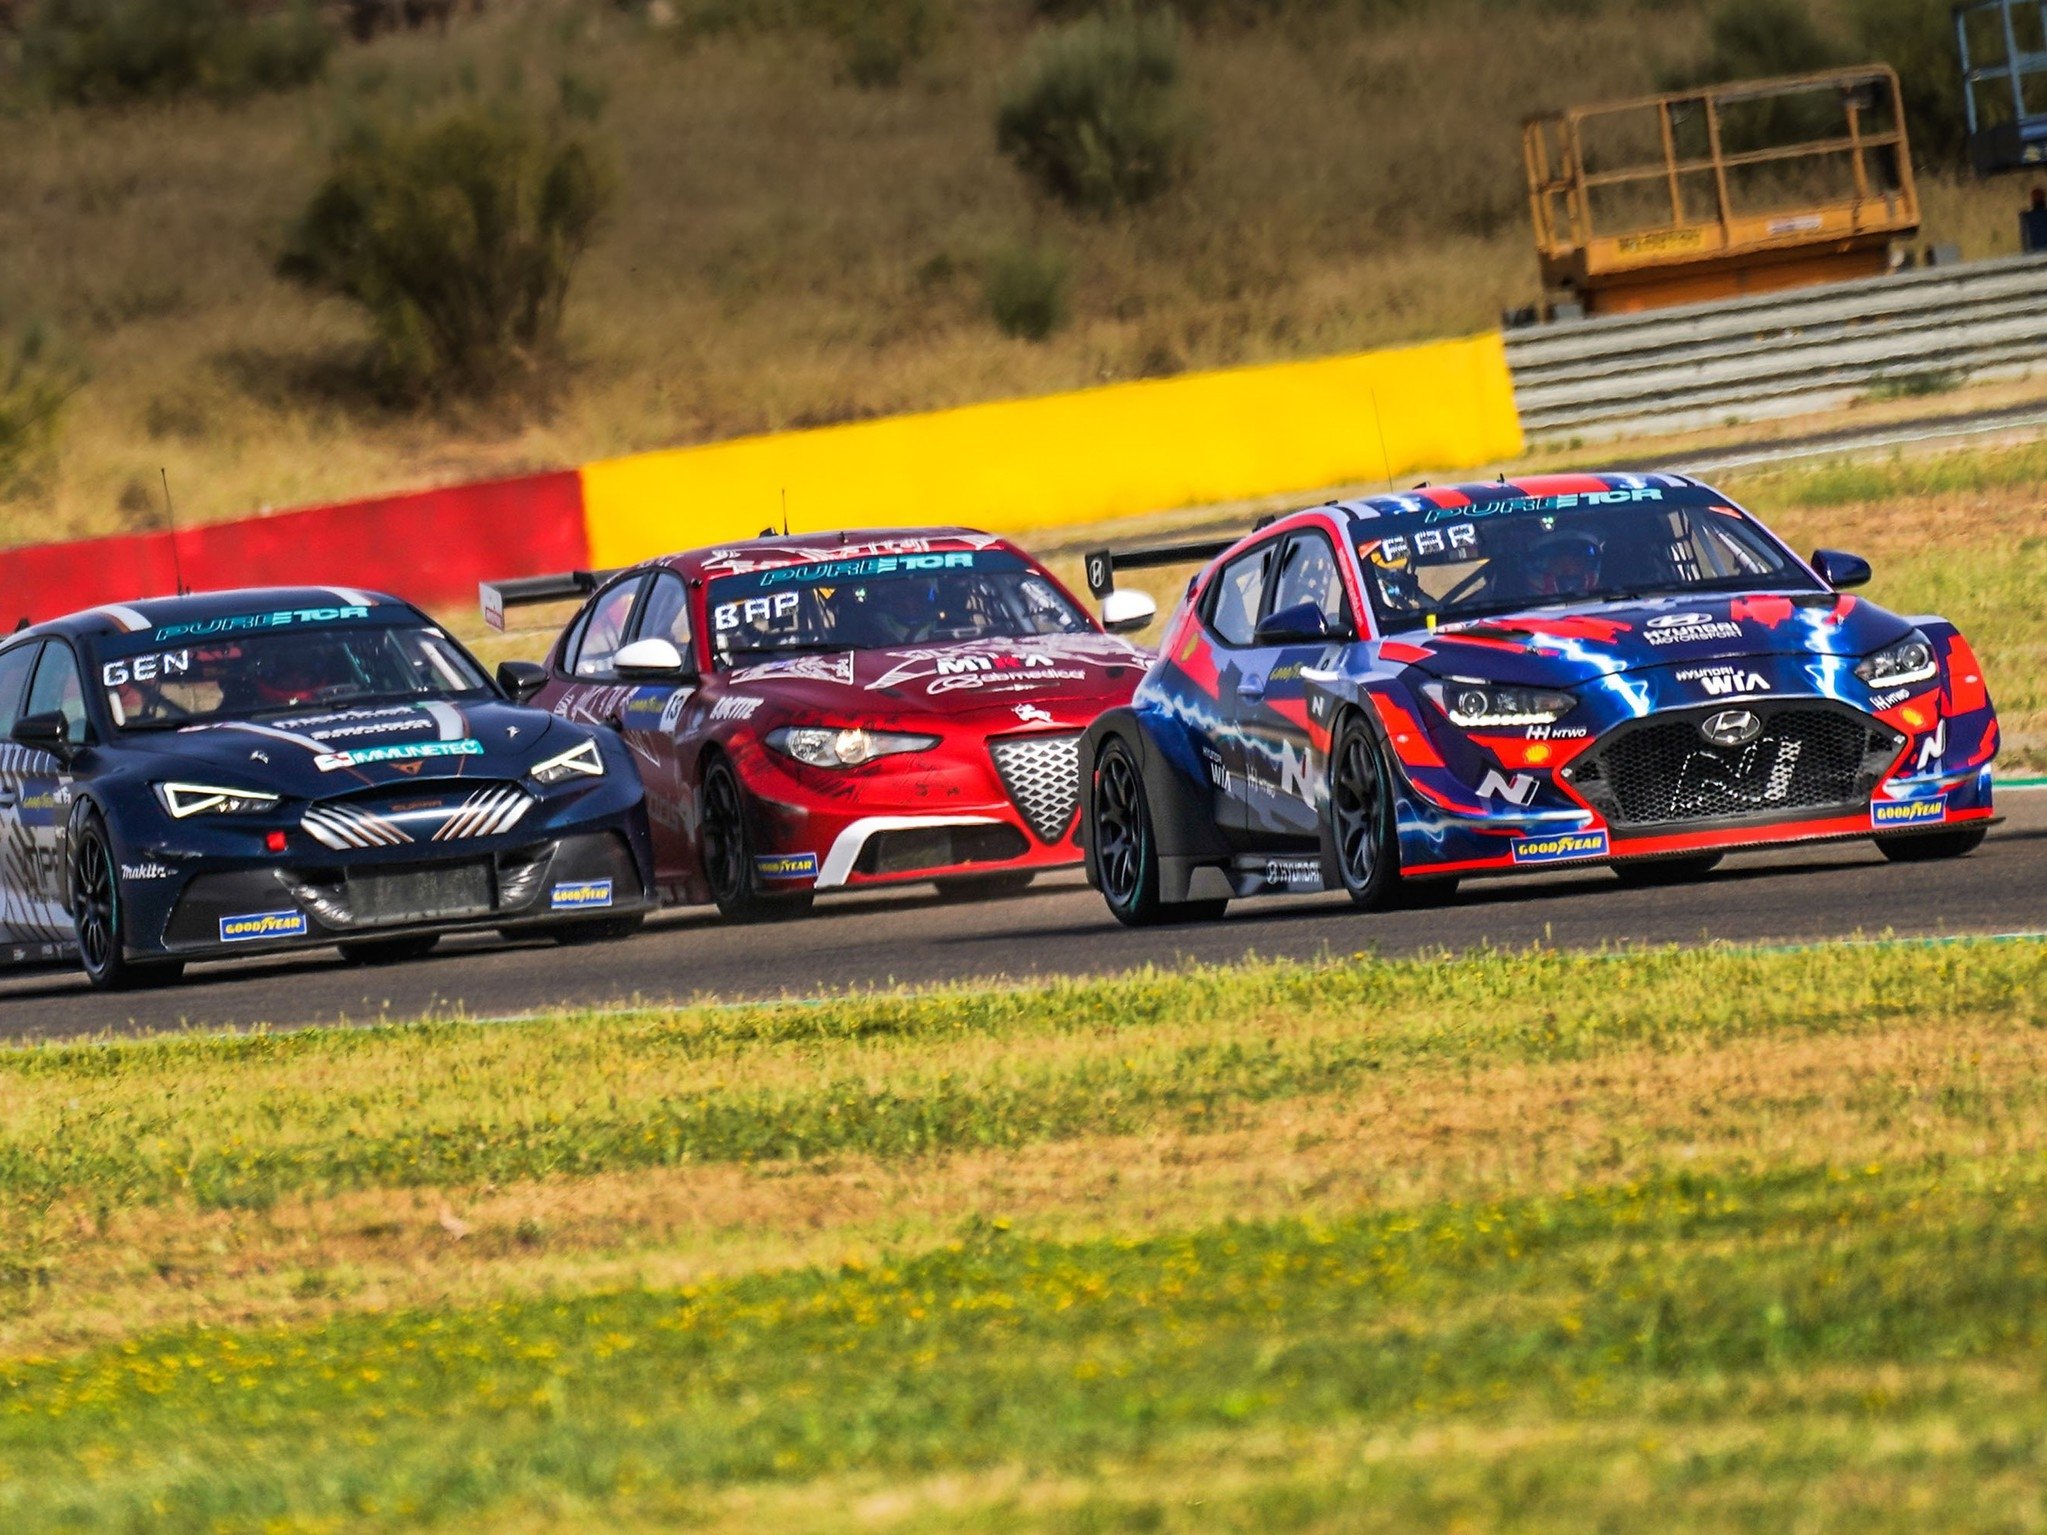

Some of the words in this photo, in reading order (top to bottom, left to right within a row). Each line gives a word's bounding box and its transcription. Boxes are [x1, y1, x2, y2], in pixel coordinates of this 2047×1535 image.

[1643, 622, 1742, 641] HYUNDAI
[1649, 630, 1739, 646] MOTORSPORT
[103, 650, 189, 687] GEN
[1676, 666, 1735, 682] HYUNDAI
[1701, 669, 1771, 695] WIA
[1552, 726, 1588, 739] HTWO
[1877, 802, 1942, 820] GOODYEAR
[1518, 836, 1603, 855] GOODYEAR
[225, 915, 300, 935] GOODYEAR
